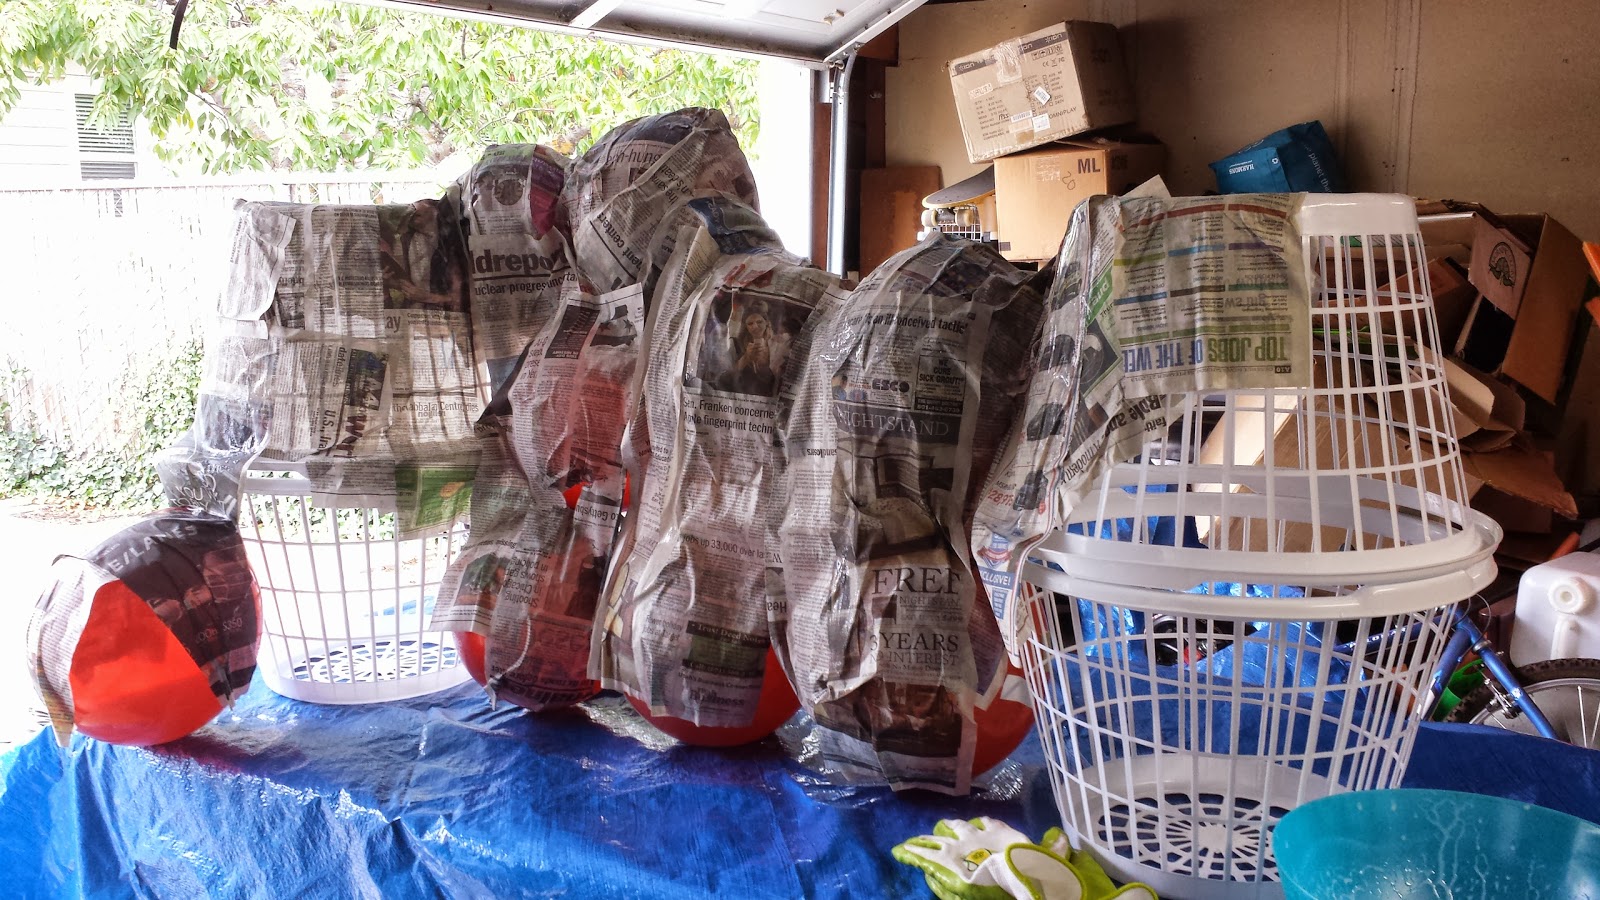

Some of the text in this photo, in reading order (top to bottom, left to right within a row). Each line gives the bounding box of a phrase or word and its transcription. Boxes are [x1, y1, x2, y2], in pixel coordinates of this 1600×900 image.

[1047, 106, 1078, 120] OMNIPLAY
[1078, 157, 1101, 174] ML
[1308, 152, 1325, 178] planet
[1155, 342, 1184, 369] THE
[1187, 339, 1203, 366] OF
[1208, 337, 1251, 363] JOBS
[1254, 336, 1286, 362] TOP
[919, 373, 935, 382] SICK
[933, 367, 952, 376] CURE
[699, 400, 733, 414] Franken
[703, 412, 746, 431] fingerprint
[836, 406, 950, 437] NIGHTSTAND
[711, 539, 738, 554] 33,000
[739, 546, 755, 557] over
[520, 571, 545, 584] shows
[504, 590, 539, 607] Shooting
[767, 601, 787, 613] Hea
[720, 628, 742, 640] Deed
[869, 631, 959, 652] 3 YEARS
[889, 651, 960, 666] INTEREST
